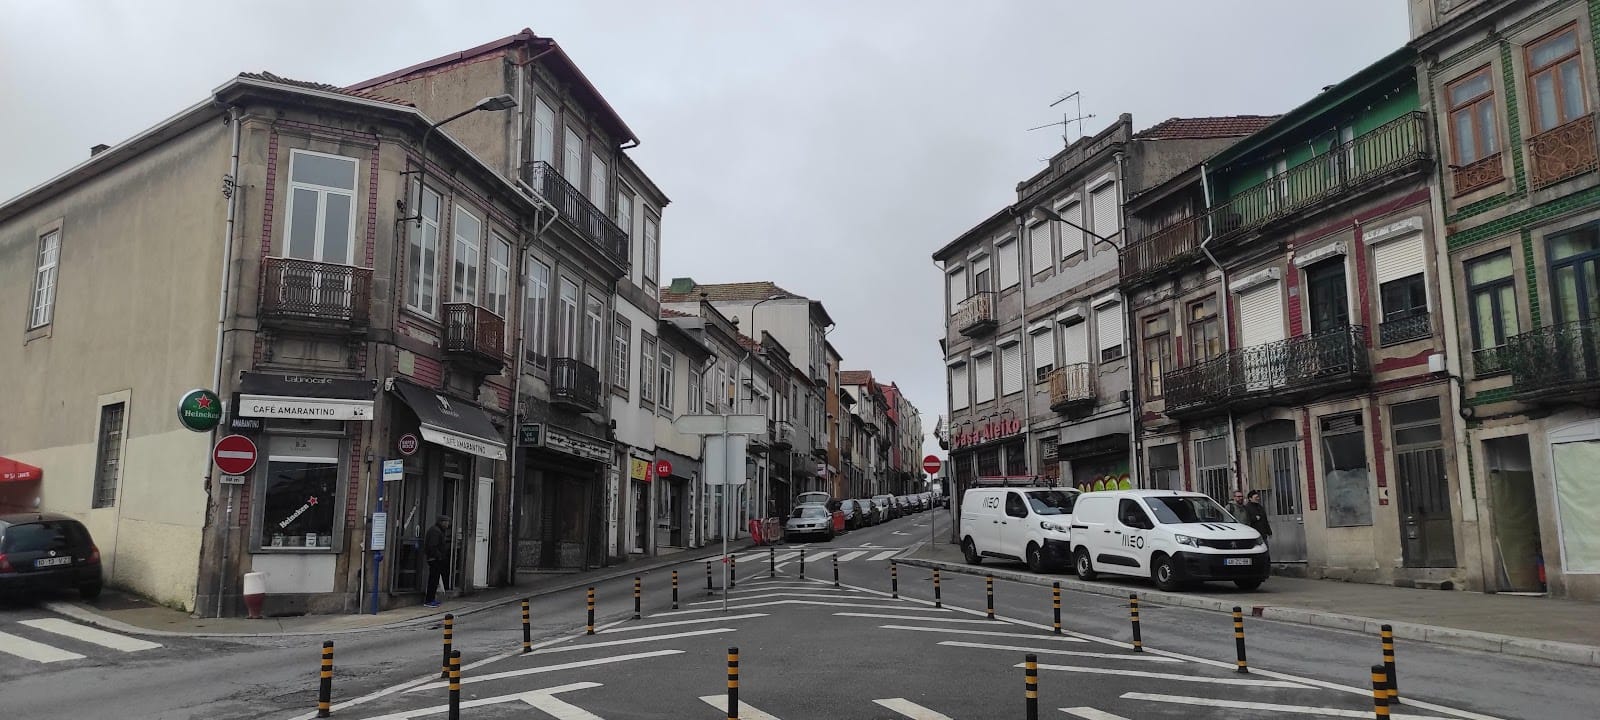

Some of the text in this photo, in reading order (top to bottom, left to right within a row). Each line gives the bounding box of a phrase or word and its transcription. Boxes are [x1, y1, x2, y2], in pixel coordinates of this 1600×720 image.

[184, 409, 220, 419] Heineken
[278, 406, 335, 416] AMARANTINO
[232, 419, 260, 428] AMARANTINO
[954, 418, 1021, 447] Casa Aleiko
[658, 465, 668, 473] ctt
[982, 496, 1000, 509] MEO
[280, 503, 310, 529] Heineken
[1122, 533, 1145, 549] MEO
